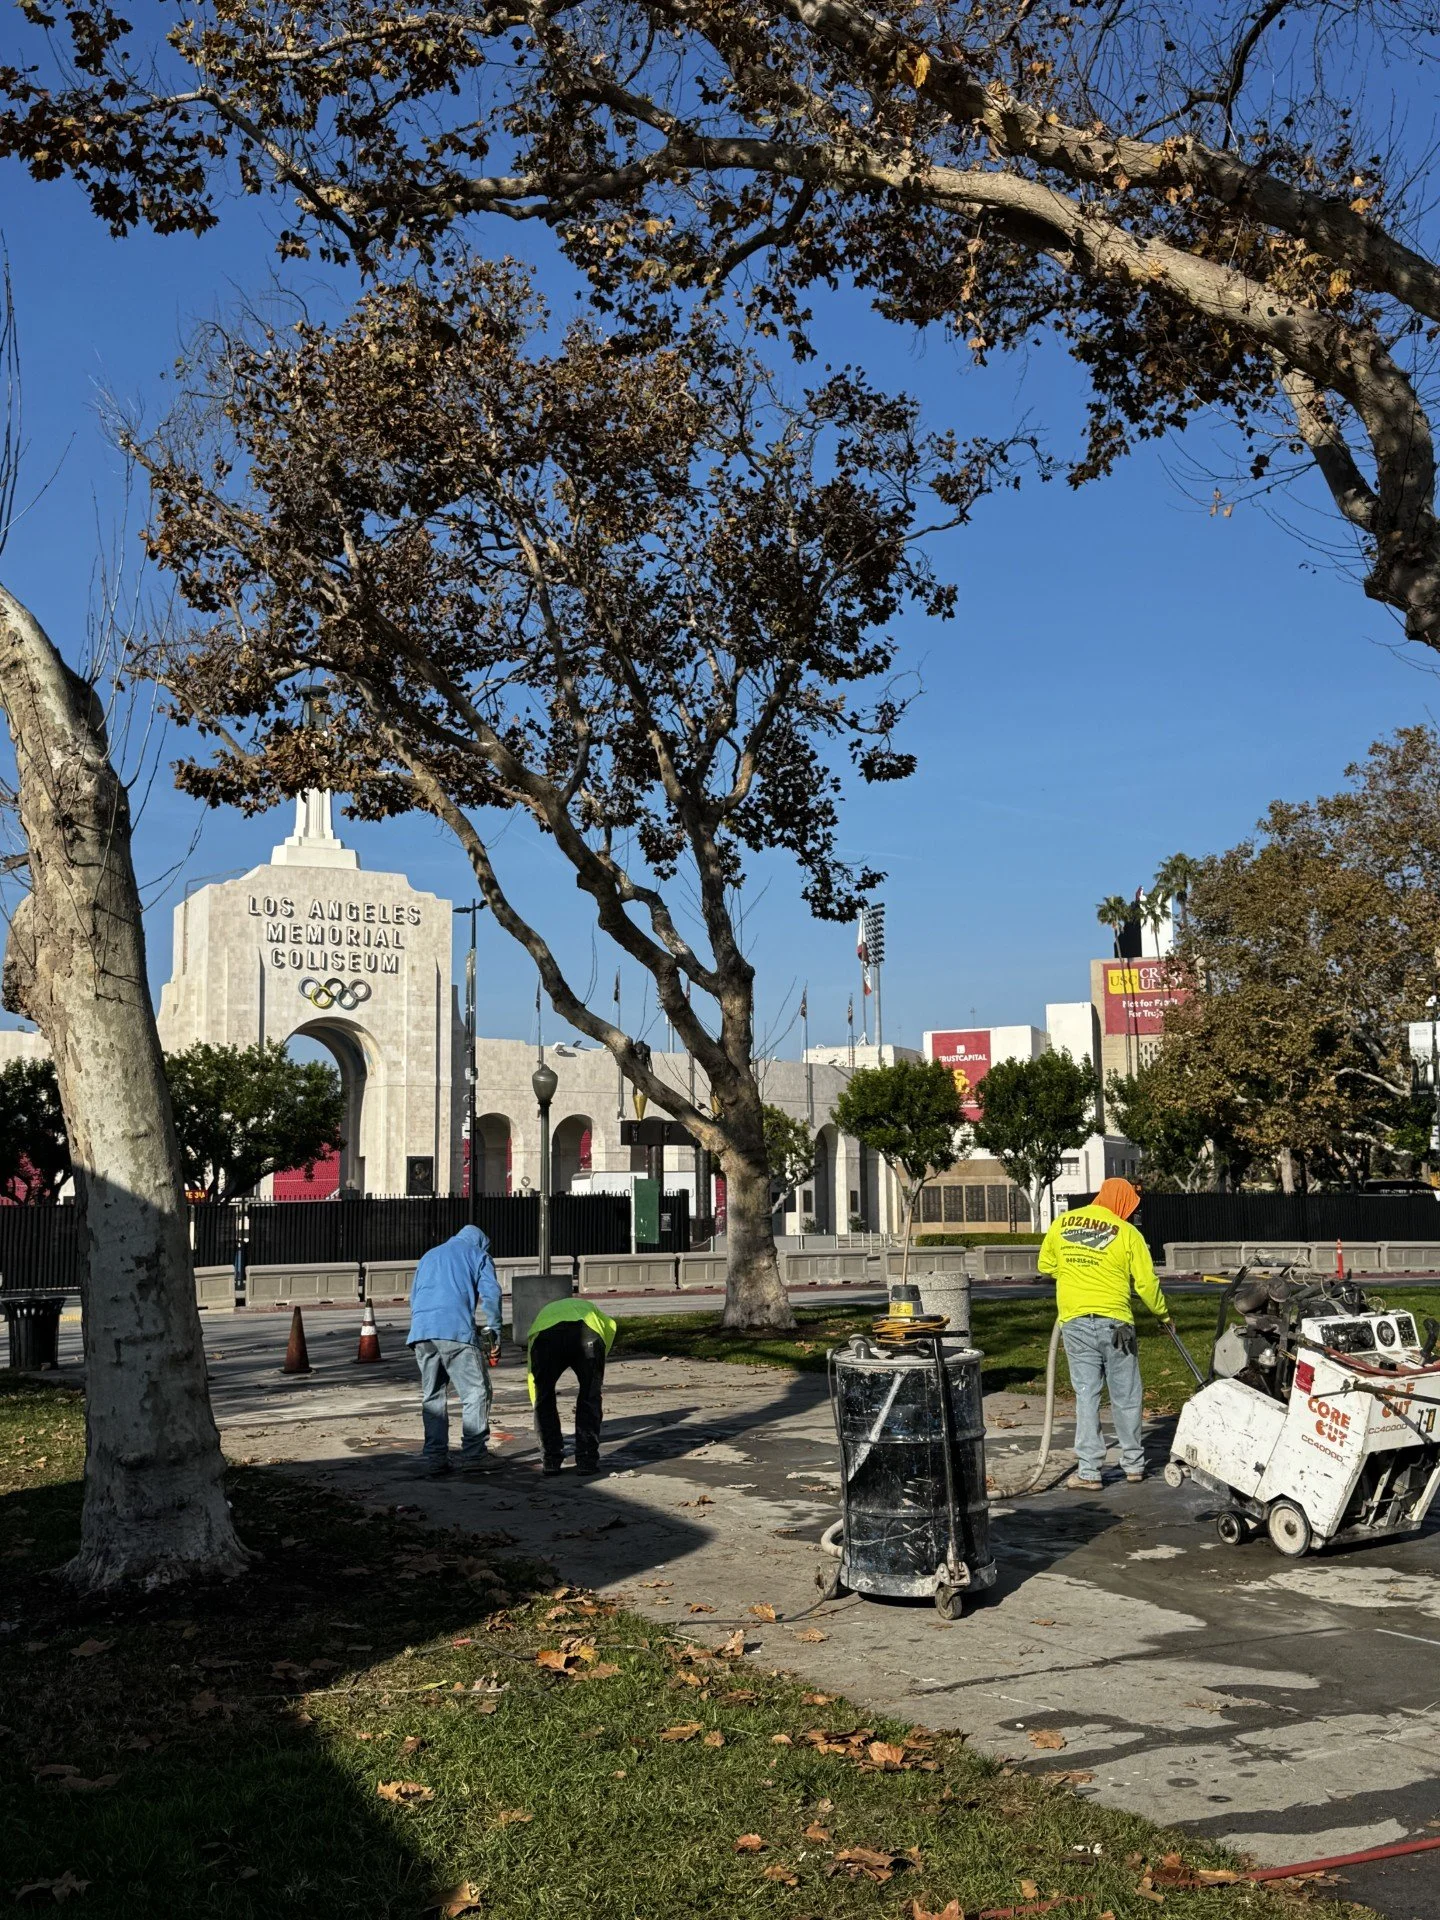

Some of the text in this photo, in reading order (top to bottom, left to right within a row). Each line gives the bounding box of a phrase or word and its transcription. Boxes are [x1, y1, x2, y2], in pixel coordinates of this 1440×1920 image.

[249, 894, 421, 925] LOS ANGELES
[266, 921, 405, 949] MEMORIAL
[271, 947, 399, 974] COLISEUM
[1110, 975, 1137, 987] USC
[1140, 999, 1153, 1008] for
[1061, 1216, 1120, 1236] LOZANO'S
[1308, 1397, 1351, 1427] CORE
[1315, 1419, 1348, 1448] CUT
